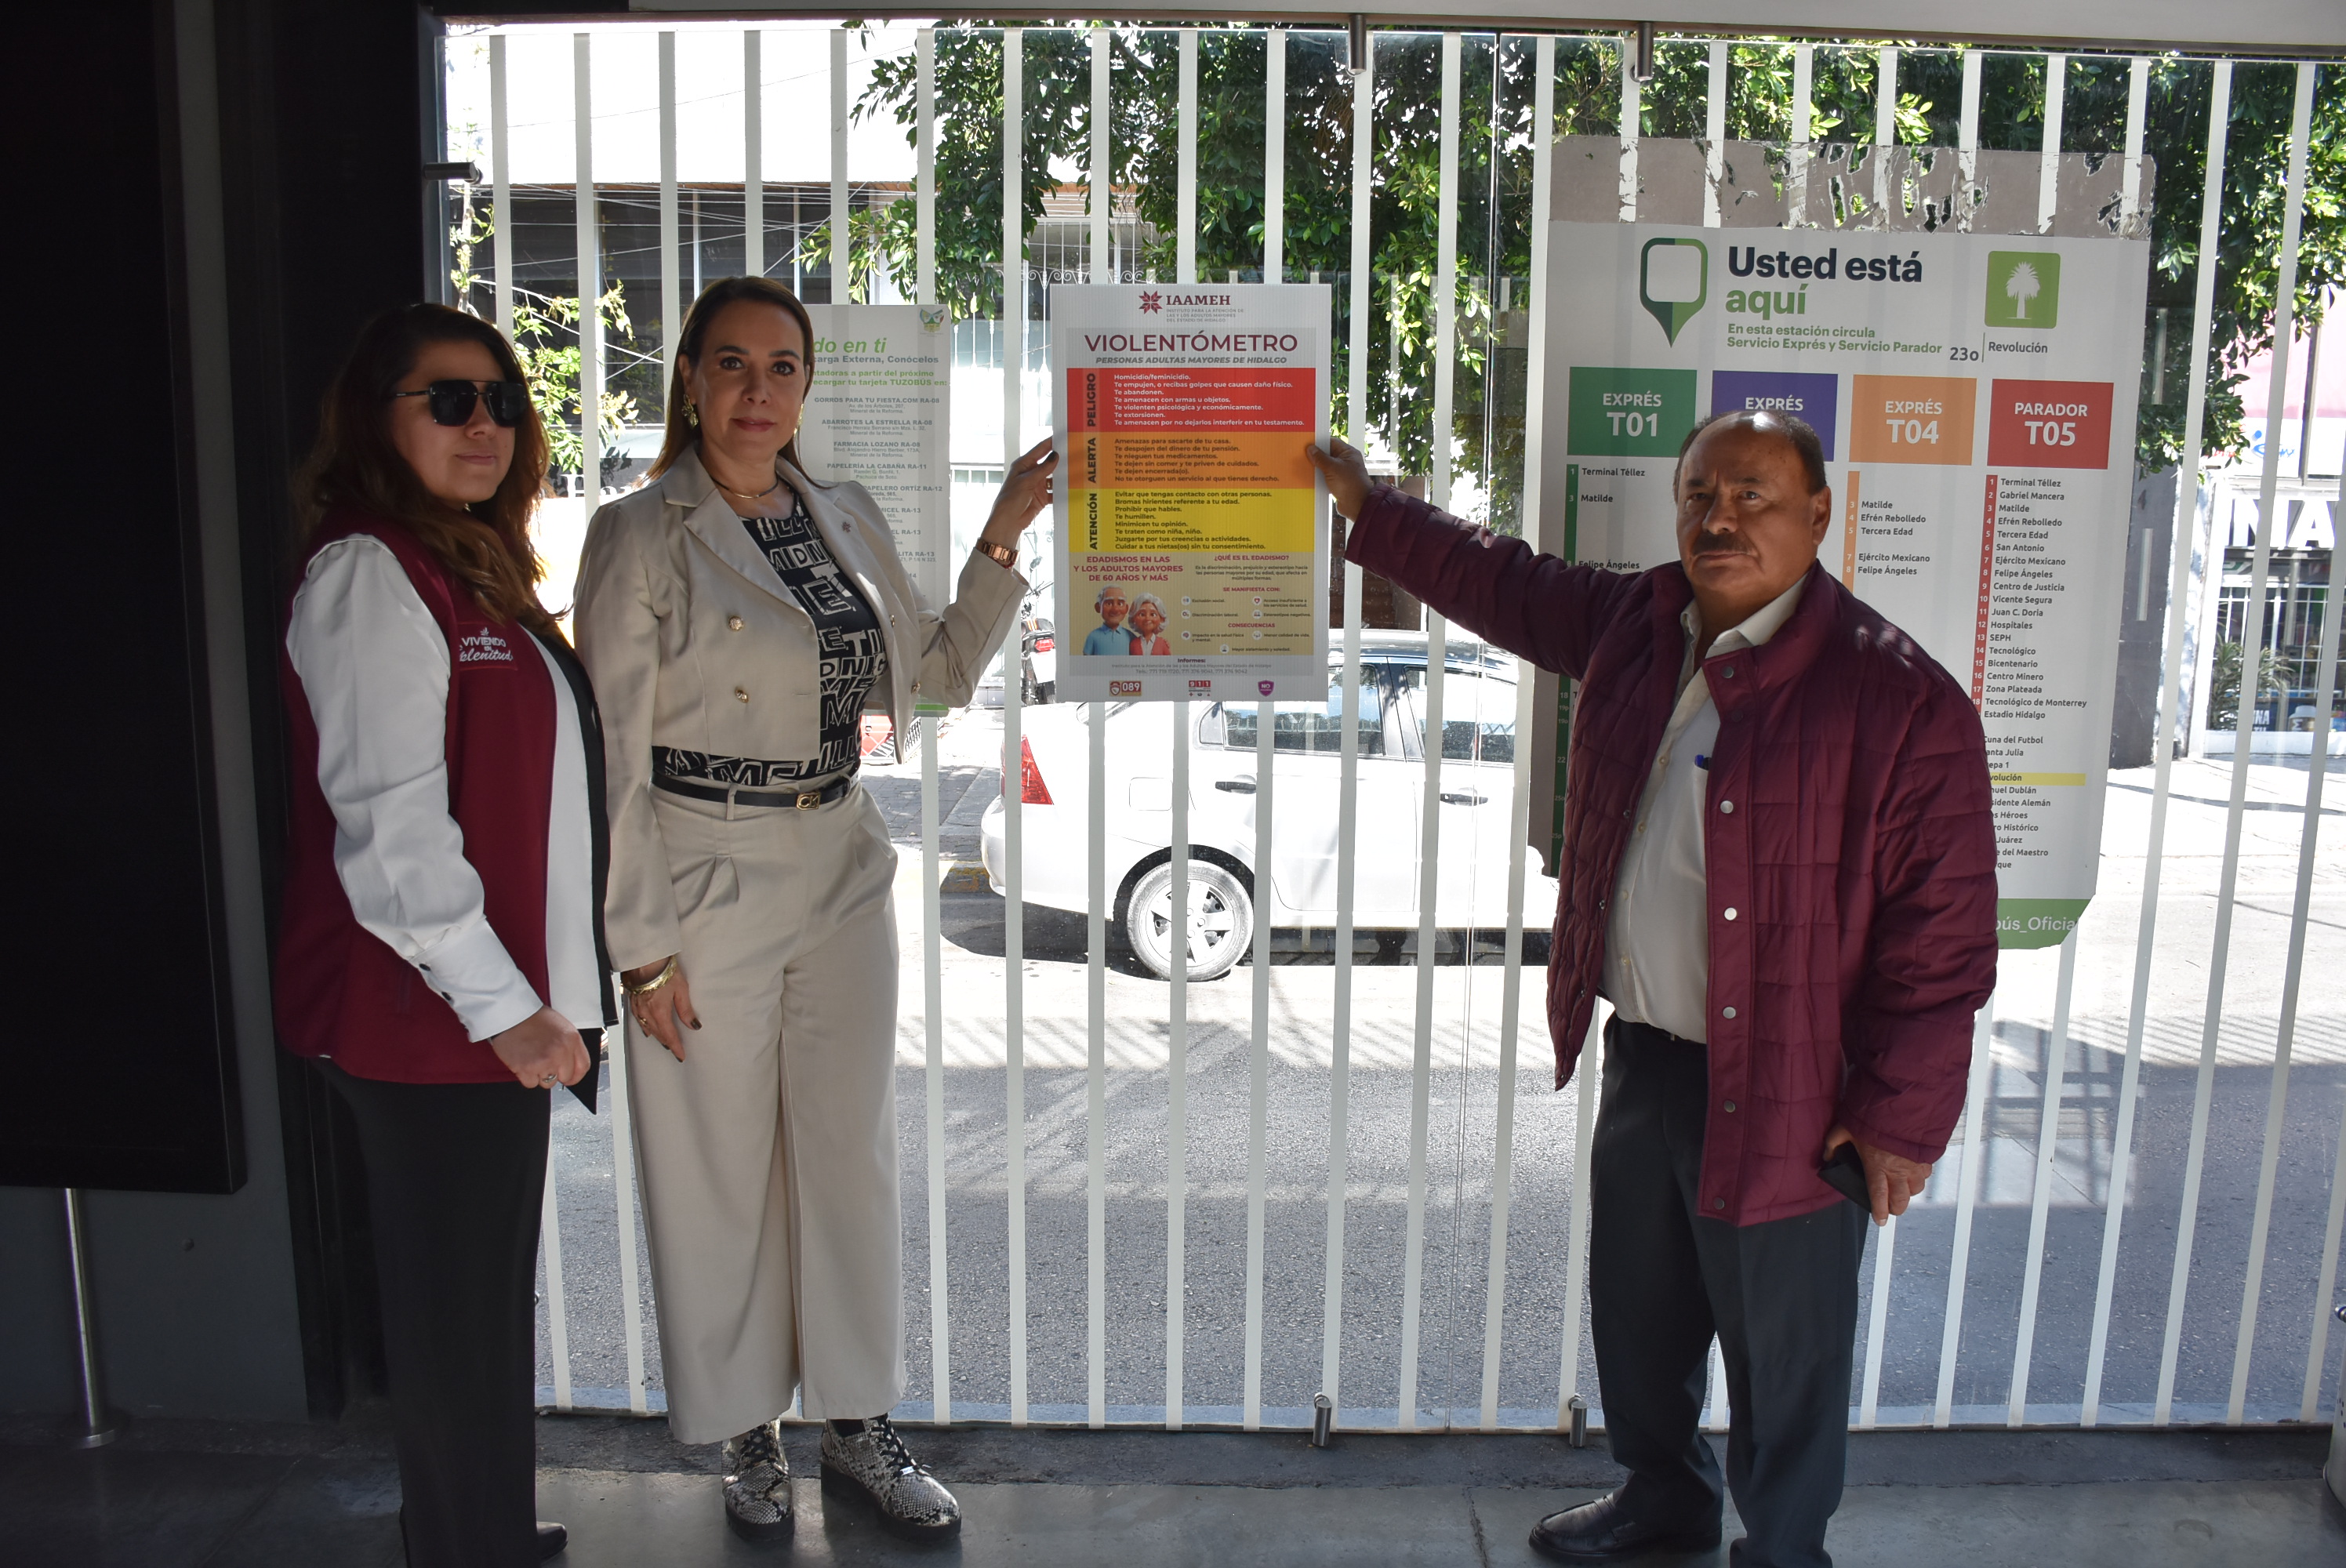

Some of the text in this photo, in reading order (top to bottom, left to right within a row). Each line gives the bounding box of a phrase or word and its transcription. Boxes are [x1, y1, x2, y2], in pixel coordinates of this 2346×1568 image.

[1729, 246, 1923, 283] Usted está
[1167, 295, 1231, 307] IAAMEH
[1725, 284, 1809, 321] aquí
[1728, 324, 1876, 338] En esta estación circula
[844, 341, 867, 353] en
[874, 338, 887, 353] ti
[1084, 330, 1298, 351] VIOLENTÓMETRO
[1727, 337, 1942, 353] Servicio Exprés y Servicio Parador
[1988, 341, 2048, 353] Revolución
[1087, 373, 1096, 426] PELIGRO
[1603, 391, 1661, 407] EXPRÉS
[1745, 397, 1803, 412] EXPRÉS
[1885, 399, 1942, 415] EXPRÉS
[2014, 402, 2087, 416] PARADOR
[1607, 412, 1657, 437] T01
[1887, 419, 1939, 444] T04
[2025, 421, 2075, 446] T05
[1088, 438, 1096, 483] ALERTA
[1620, 468, 1646, 477] Téllez
[1580, 494, 1613, 503] Matilde
[2000, 491, 2028, 499] Gabriel
[1861, 500, 1893, 510] Matilde
[1087, 493, 1098, 550] ATENCIÓN
[1885, 514, 1926, 523] Rebolledo
[1999, 517, 2020, 525] Efrén
[1894, 528, 1913, 536] Edad
[1858, 553, 1890, 562] Ejército
[1996, 557, 2026, 565] Ejército
[1607, 559, 1640, 570] Ángeles
[1858, 565, 1917, 576] Felipe Ángeles
[1995, 569, 2053, 579] Felipe Ángeles
[2025, 596, 2052, 605] Segura
[1991, 621, 2032, 630] Hospitales
[462, 637, 506, 647] VIVIENDO
[1988, 647, 2036, 656] Tecnológico
[1122, 683, 1140, 691] 089
[1985, 698, 2032, 707] Tecnológico
[2045, 699, 2087, 708] Monterrey
[2015, 711, 2045, 720] Hidalgo
